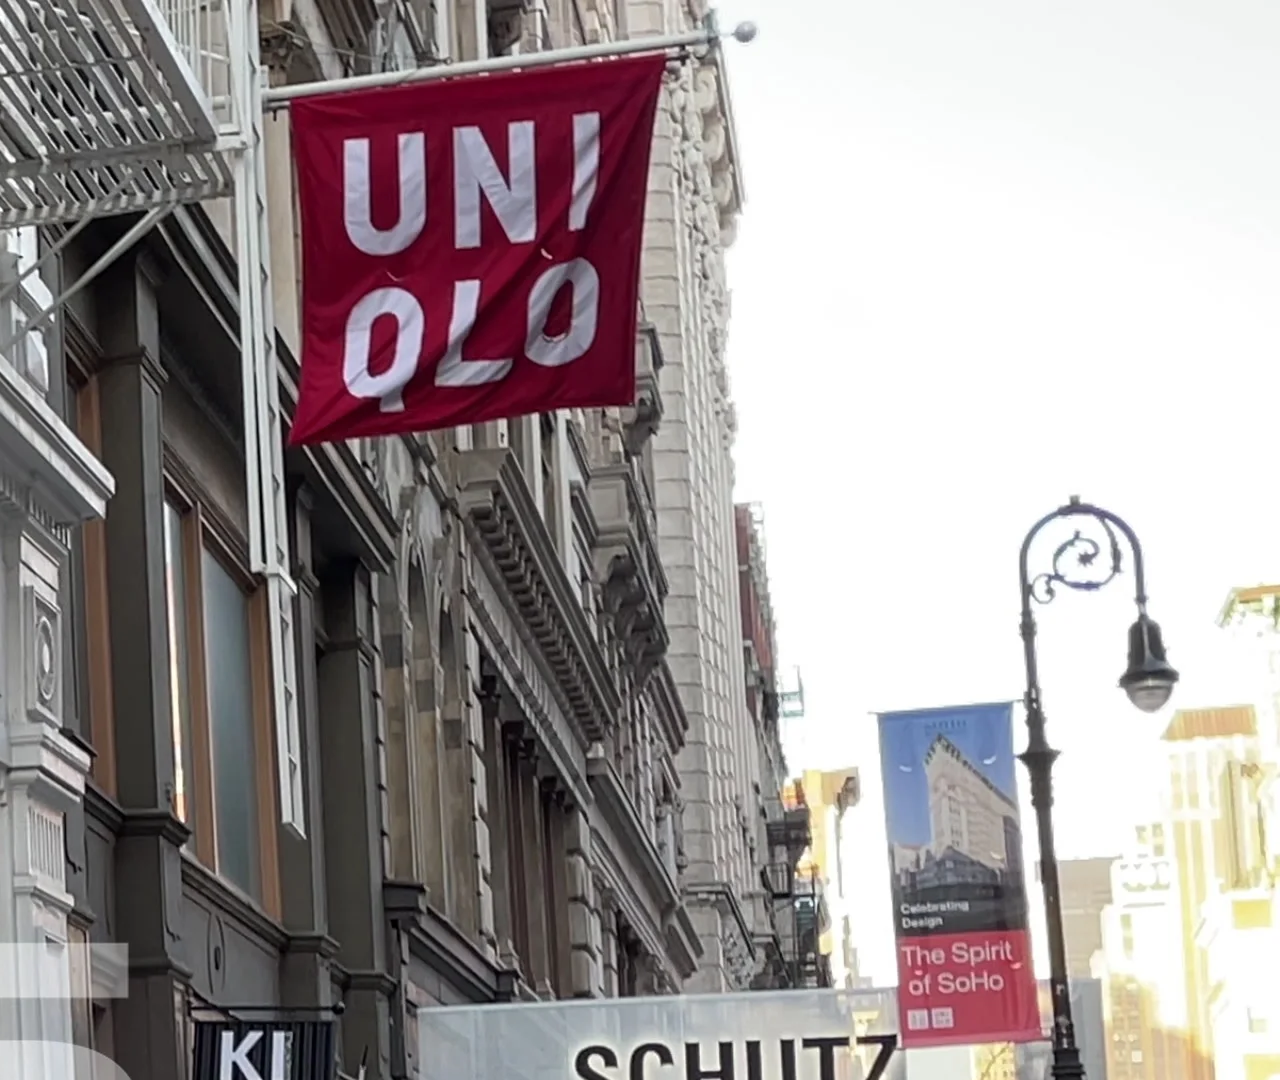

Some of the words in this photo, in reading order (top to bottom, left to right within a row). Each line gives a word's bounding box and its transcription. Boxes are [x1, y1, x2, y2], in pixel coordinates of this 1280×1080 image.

[343, 111, 600, 256] UNI
[343, 257, 600, 412] QLO
[900, 901, 969, 915] Celebrating
[902, 916, 943, 929] Design
[901, 946, 945, 967] The
[952, 940, 1014, 968] Spirit
[909, 973, 931, 996] of
[938, 971, 1004, 994] SoHo
